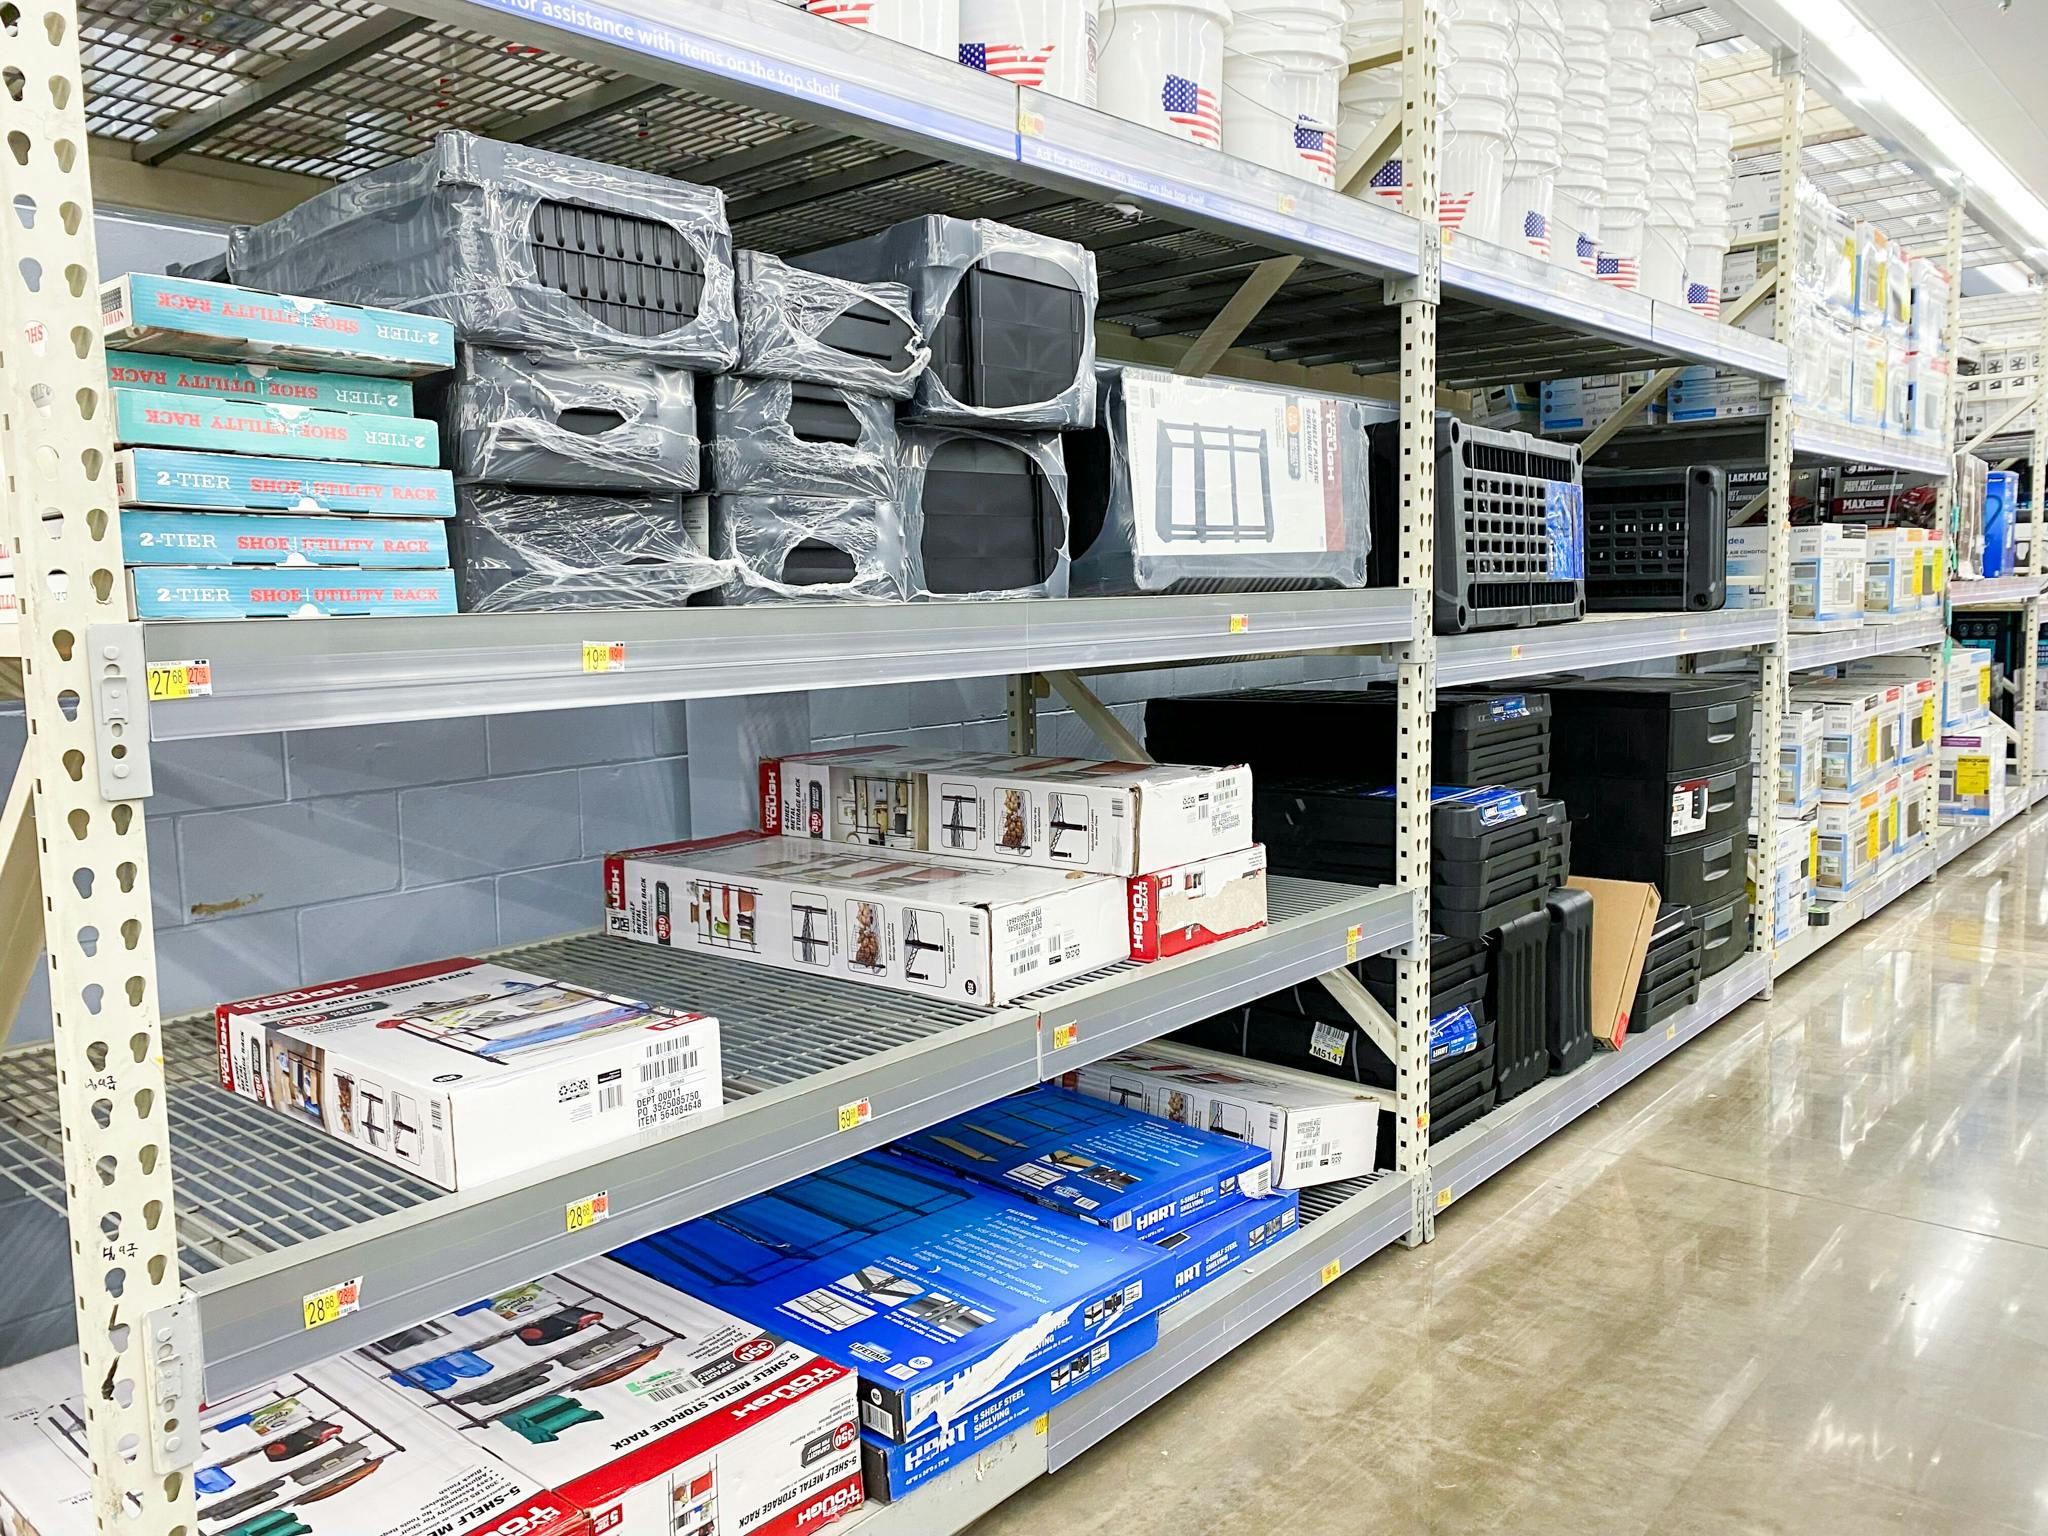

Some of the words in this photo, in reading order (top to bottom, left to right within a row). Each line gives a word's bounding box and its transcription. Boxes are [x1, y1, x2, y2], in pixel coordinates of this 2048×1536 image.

[542, 1, 634, 41] assistance
[637, 29, 676, 55] with
[679, 38, 722, 66] items
[726, 57, 747, 72] on
[749, 60, 776, 81] the
[777, 69, 804, 93] top
[1036, 147, 1052, 161] Ask
[1149, 183, 1161, 194] on
[156, 291, 211, 314] RACK
[221, 303, 302, 327] UTILITY
[314, 316, 359, 334] SHOE
[376, 323, 440, 345] 2-TIER
[110, 366, 166, 386] RACK
[177, 374, 256, 394] UTILITY
[268, 382, 318, 399] SHOE
[335, 389, 398, 407] 2-TIER
[145, 408, 201, 428] RACK
[211, 415, 288, 435] UTILITY
[301, 424, 348, 441] SHOE
[364, 430, 426, 449] 2-TIER
[1326, 411, 1336, 481] TOUGH
[156, 471, 232, 490] 2-TIER
[250, 478, 302, 494] SHOE
[313, 480, 384, 498] UTILITY
[391, 485, 438, 501] RACK
[1728, 473, 1749, 482] LACK
[1750, 471, 1769, 481] MAX
[1842, 498, 1866, 510] MAX
[139, 532, 217, 549] 2-TIER
[237, 535, 290, 550] SHOE
[301, 537, 374, 552] UTILITY
[383, 538, 430, 553] RACK
[156, 587, 232, 602] 2-TIER
[250, 588, 302, 602] SHOE
[313, 588, 384, 602] UTILITY
[391, 587, 438, 601] RACK
[152, 670, 171, 696] 27
[768, 771, 777, 829] TOUGH
[811, 813, 819, 832] 350
[611, 868, 620, 908] UGH
[1138, 880, 1149, 922] HYPER
[1131, 880, 1145, 952] TOUGH
[658, 917, 667, 937] 350
[240, 982, 360, 1011] TOUGH
[325, 993, 373, 1007] METAL
[375, 980, 437, 995] STORAGE
[438, 970, 474, 982] RACK
[220, 1016, 230, 1081] TOUGH
[1311, 1045, 1344, 1065] M5141
[1432, 1045, 1449, 1058] HART
[636, 1094, 656, 1108] DEPT
[657, 1087, 681, 1102] 00011
[637, 1106, 648, 1118] PO
[652, 1090, 699, 1113] 3525085750
[638, 1113, 657, 1127] ITEM
[660, 1098, 702, 1120] 564084648
[1180, 1191, 1201, 1204] 5-SHELF
[1200, 1186, 1214, 1197] STEEL
[1180, 1197, 1204, 1213] SHELVING
[569, 1206, 583, 1229] 28
[1135, 1201, 1178, 1231] HART
[1030, 1224, 1057, 1236] capacity
[1069, 1238, 1089, 1247] shelf
[1041, 1236, 1066, 1248] shelves
[1053, 1256, 1080, 1270] storage
[1205, 1247, 1225, 1265] 5-SHELF
[1224, 1240, 1238, 1253] STEEL
[1205, 1253, 1229, 1272] SHELVING
[967, 1257, 996, 1272] vertically
[1003, 1271, 1043, 1291] horizontally
[971, 1269, 987, 1279] with
[987, 1275, 1007, 1287] black
[1175, 1261, 1202, 1289] ART
[307, 1298, 325, 1325] 28
[739, 1341, 773, 1361] 350
[850, 1343, 889, 1363] LIFETIME
[698, 1363, 736, 1384] CAPACITY
[752, 1353, 800, 1384] 5-SHELF
[708, 1380, 751, 1402] METAL
[731, 1366, 833, 1420] TOUGH
[973, 1414, 979, 1423] 5
[979, 1402, 1004, 1420] SHELF
[1003, 1388, 1026, 1406] STEEL
[649, 1401, 709, 1432] STORAGE
[973, 1407, 1010, 1434] SHELVING
[610, 1429, 650, 1451] RACK
[834, 1427, 855, 1448] 350
[904, 1419, 968, 1472] HART
[806, 1444, 831, 1461] CAPACITY
[462, 1468, 483, 1482] Black
[825, 1455, 857, 1480] 5-SHELF
[438, 1480, 462, 1495] Finish
[450, 1472, 488, 1497] Adjustable
[476, 1476, 494, 1487] Easy
[799, 1472, 825, 1493] METAL
[419, 1494, 450, 1512] Shelves
[440, 1486, 476, 1507] Assembly
[469, 1488, 485, 1498] LBS
[762, 1487, 798, 1515] STORAGE
[421, 1509, 433, 1518] No
[437, 1496, 469, 1516] Capacity
[458, 1485, 521, 1526] 5-SHELF
[795, 1482, 861, 1528] TOUGH
[822, 1493, 862, 1520] HYPER
[399, 1515, 421, 1528] Tools
[401, 1522, 422, 1535] Shelf
[422, 1514, 437, 1524] Per
[738, 1508, 761, 1529] RACK
